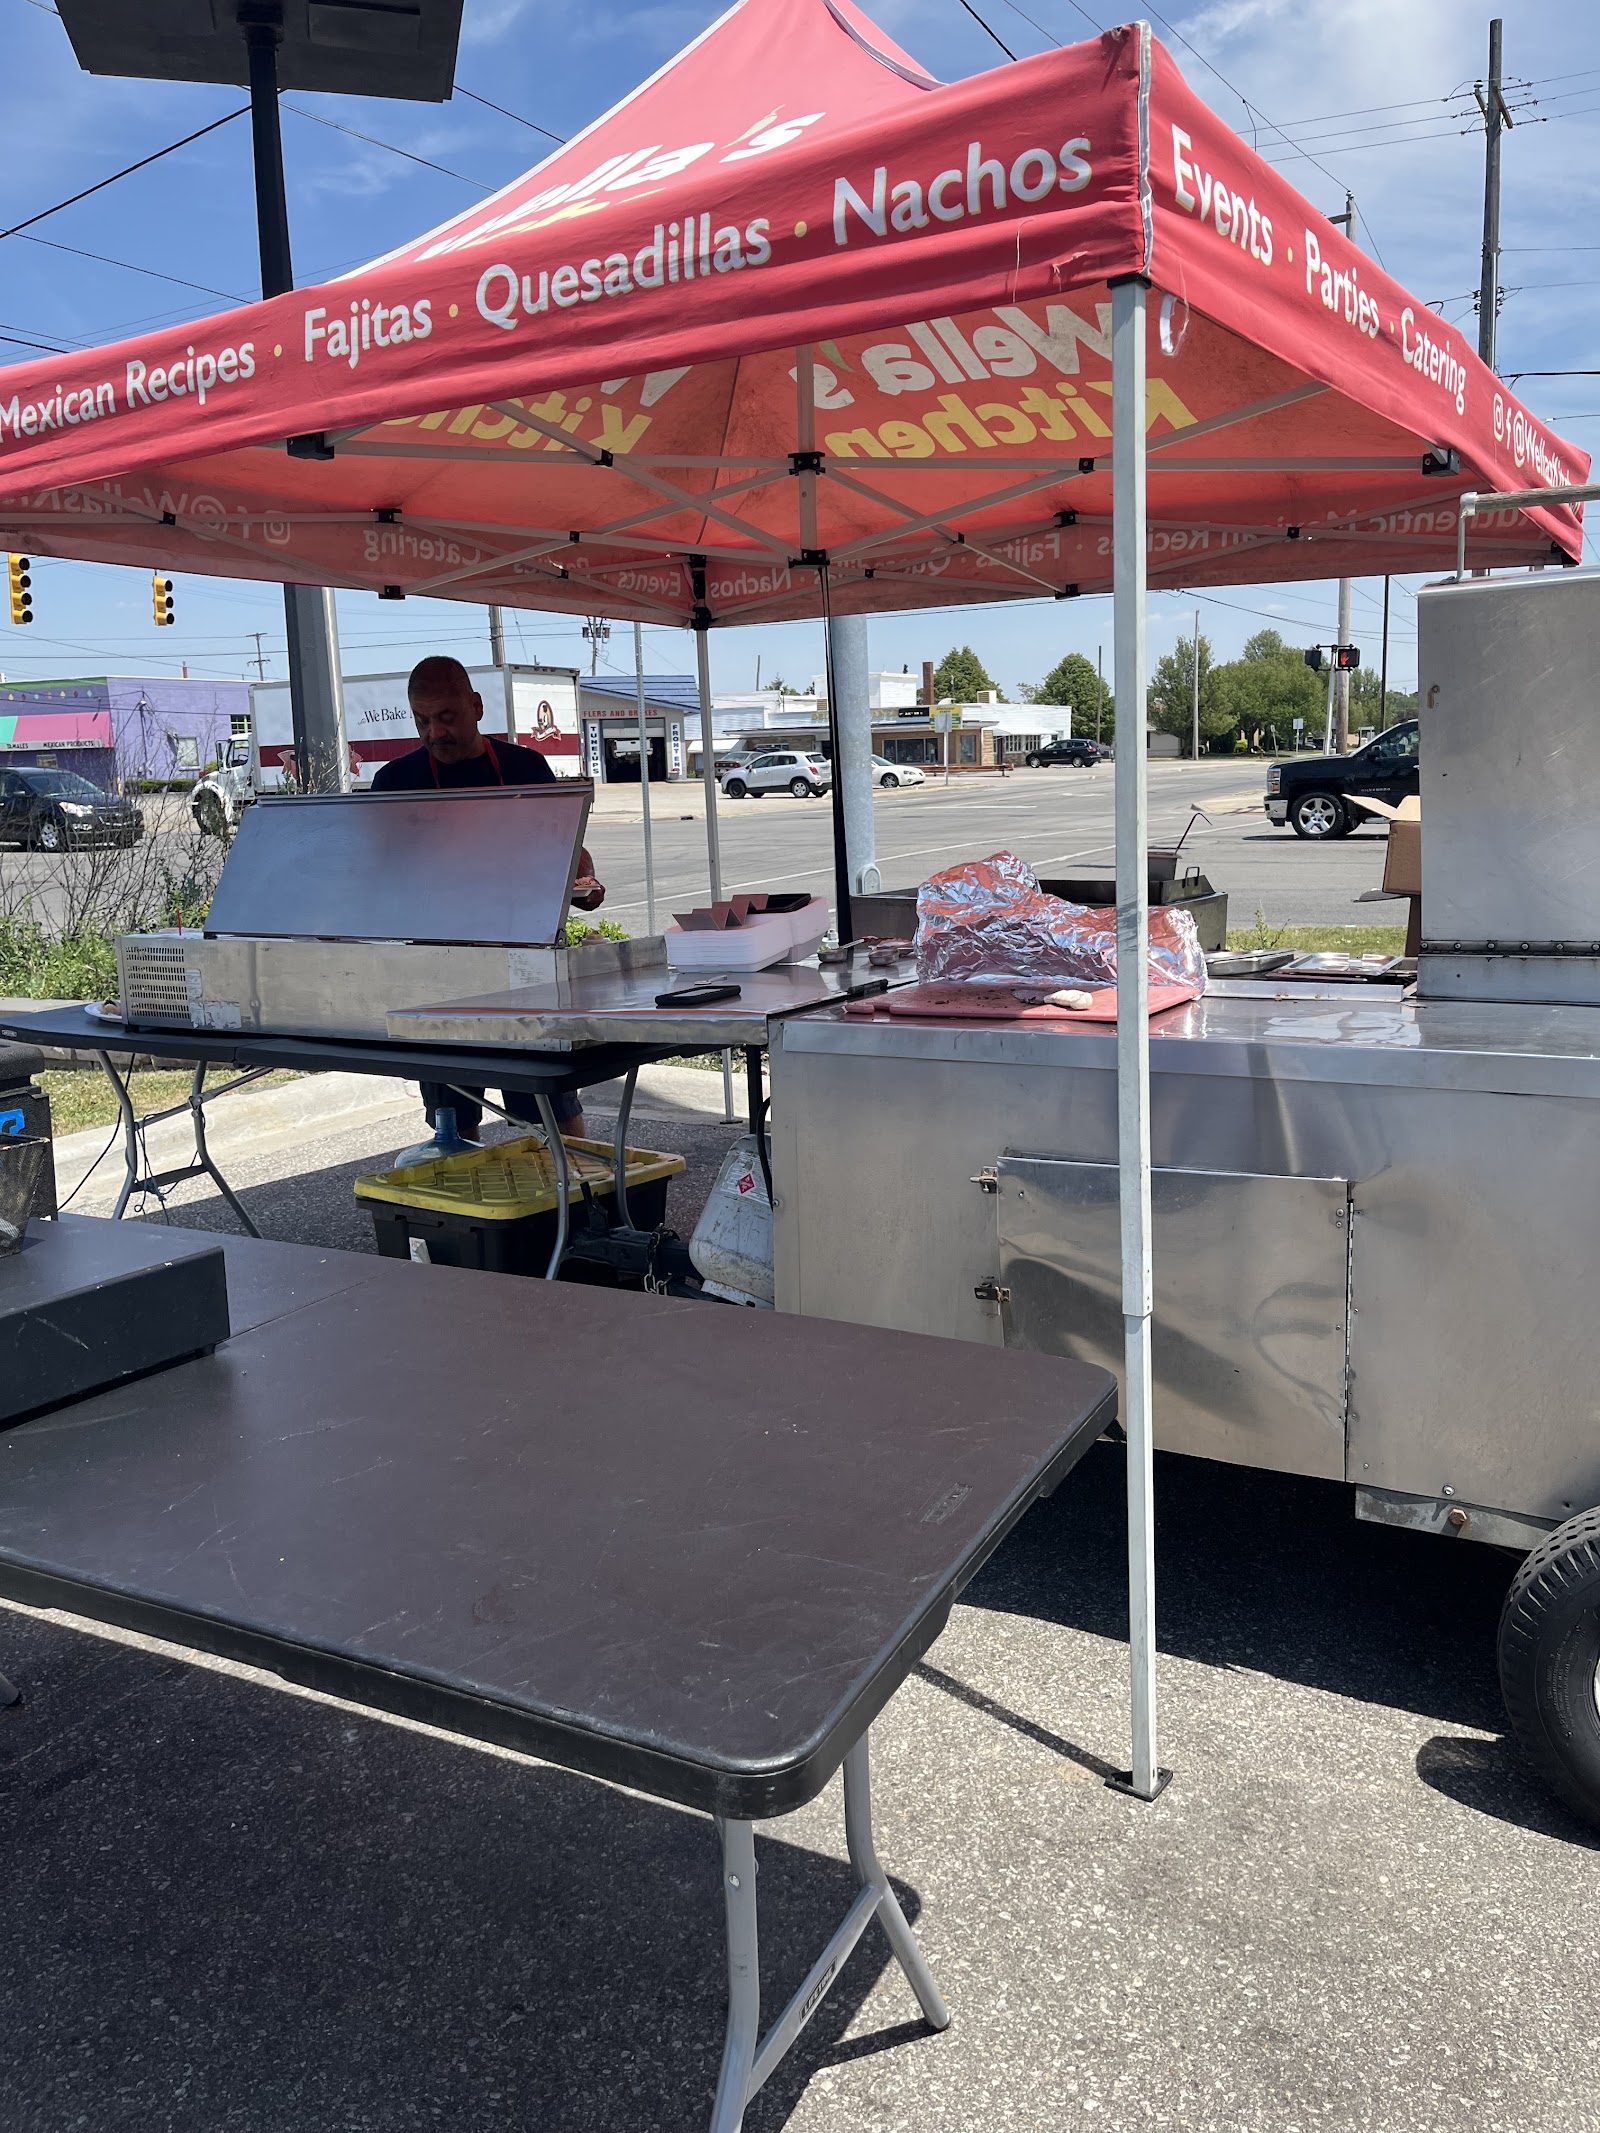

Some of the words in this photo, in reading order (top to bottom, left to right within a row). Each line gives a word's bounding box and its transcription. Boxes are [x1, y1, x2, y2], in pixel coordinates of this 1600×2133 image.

[1171, 123, 1274, 266] Events
[1305, 228, 1381, 339] Parties
[1400, 307, 1467, 416] Catering
[0, 383, 117, 443] Mexican
[126, 342, 257, 405] Recipes
[304, 298, 433, 369] Fajitas
[476, 212, 772, 330] Quesadillas
[832, 137, 1093, 245] Nachos
[365, 709, 380, 723] We
[381, 706, 407, 722] Bake
[582, 709, 607, 718] FLERS
[609, 709, 625, 717] AND
[628, 709, 658, 717] BRKES
[7, 742, 29, 750] TAMALES
[43, 740, 65, 748] MEXICAN
